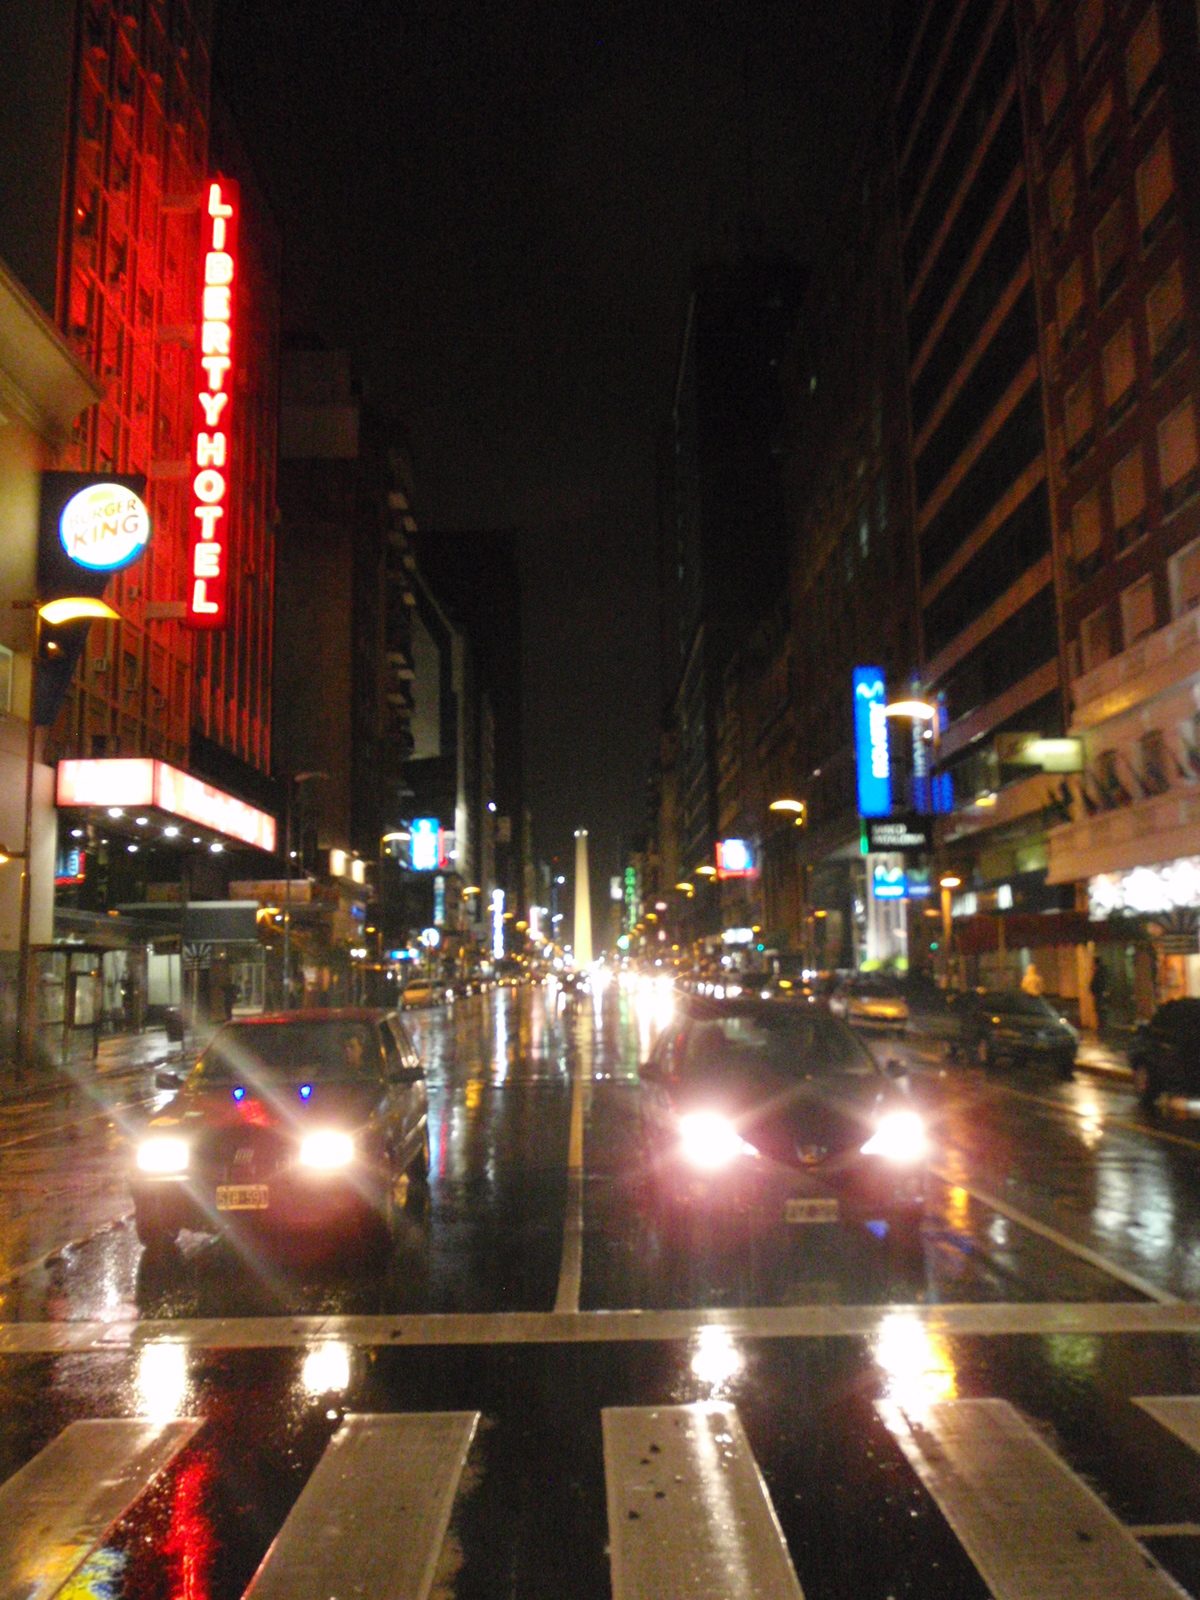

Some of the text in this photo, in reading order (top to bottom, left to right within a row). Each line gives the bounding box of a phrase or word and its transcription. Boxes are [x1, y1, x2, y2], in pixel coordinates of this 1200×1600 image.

[192, 183, 233, 613] LIBERTY HOTEL
[73, 513, 140, 551] KING
